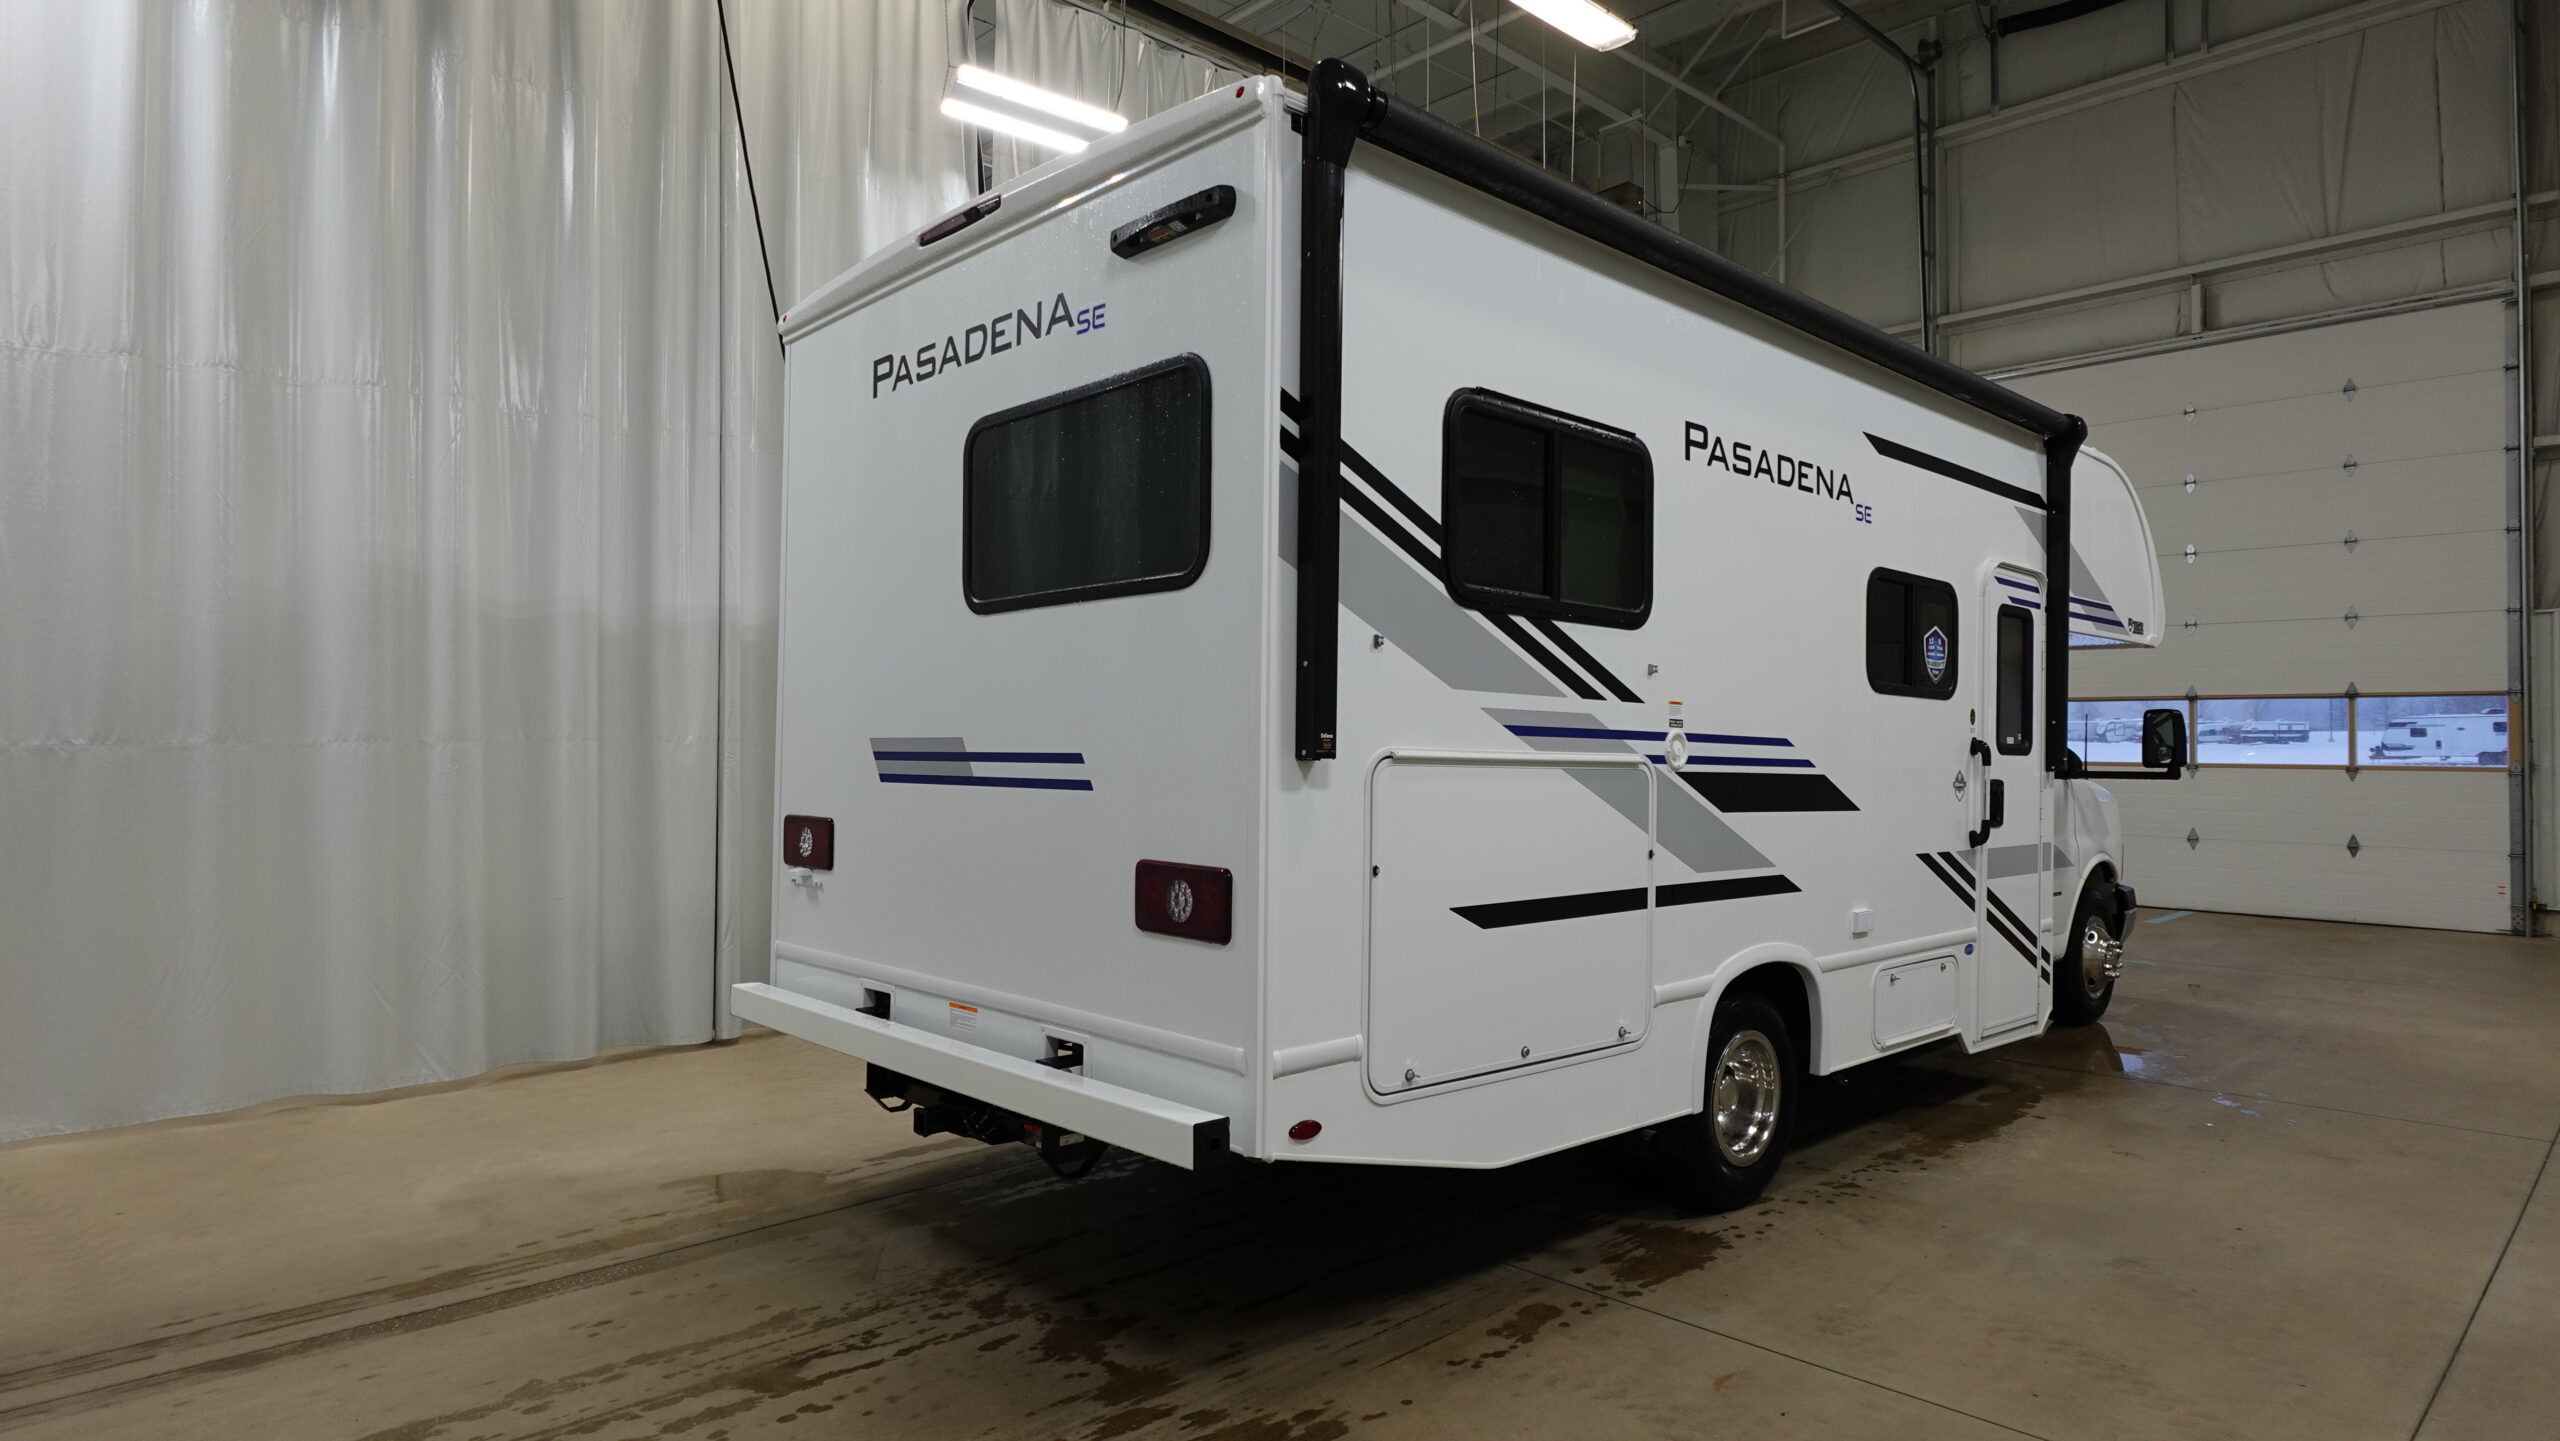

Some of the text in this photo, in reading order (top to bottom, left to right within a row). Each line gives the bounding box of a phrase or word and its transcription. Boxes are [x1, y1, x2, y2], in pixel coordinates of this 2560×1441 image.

[872, 292, 1106, 399] PASADENA SE
[1685, 421, 1873, 524] PASADENA SE
